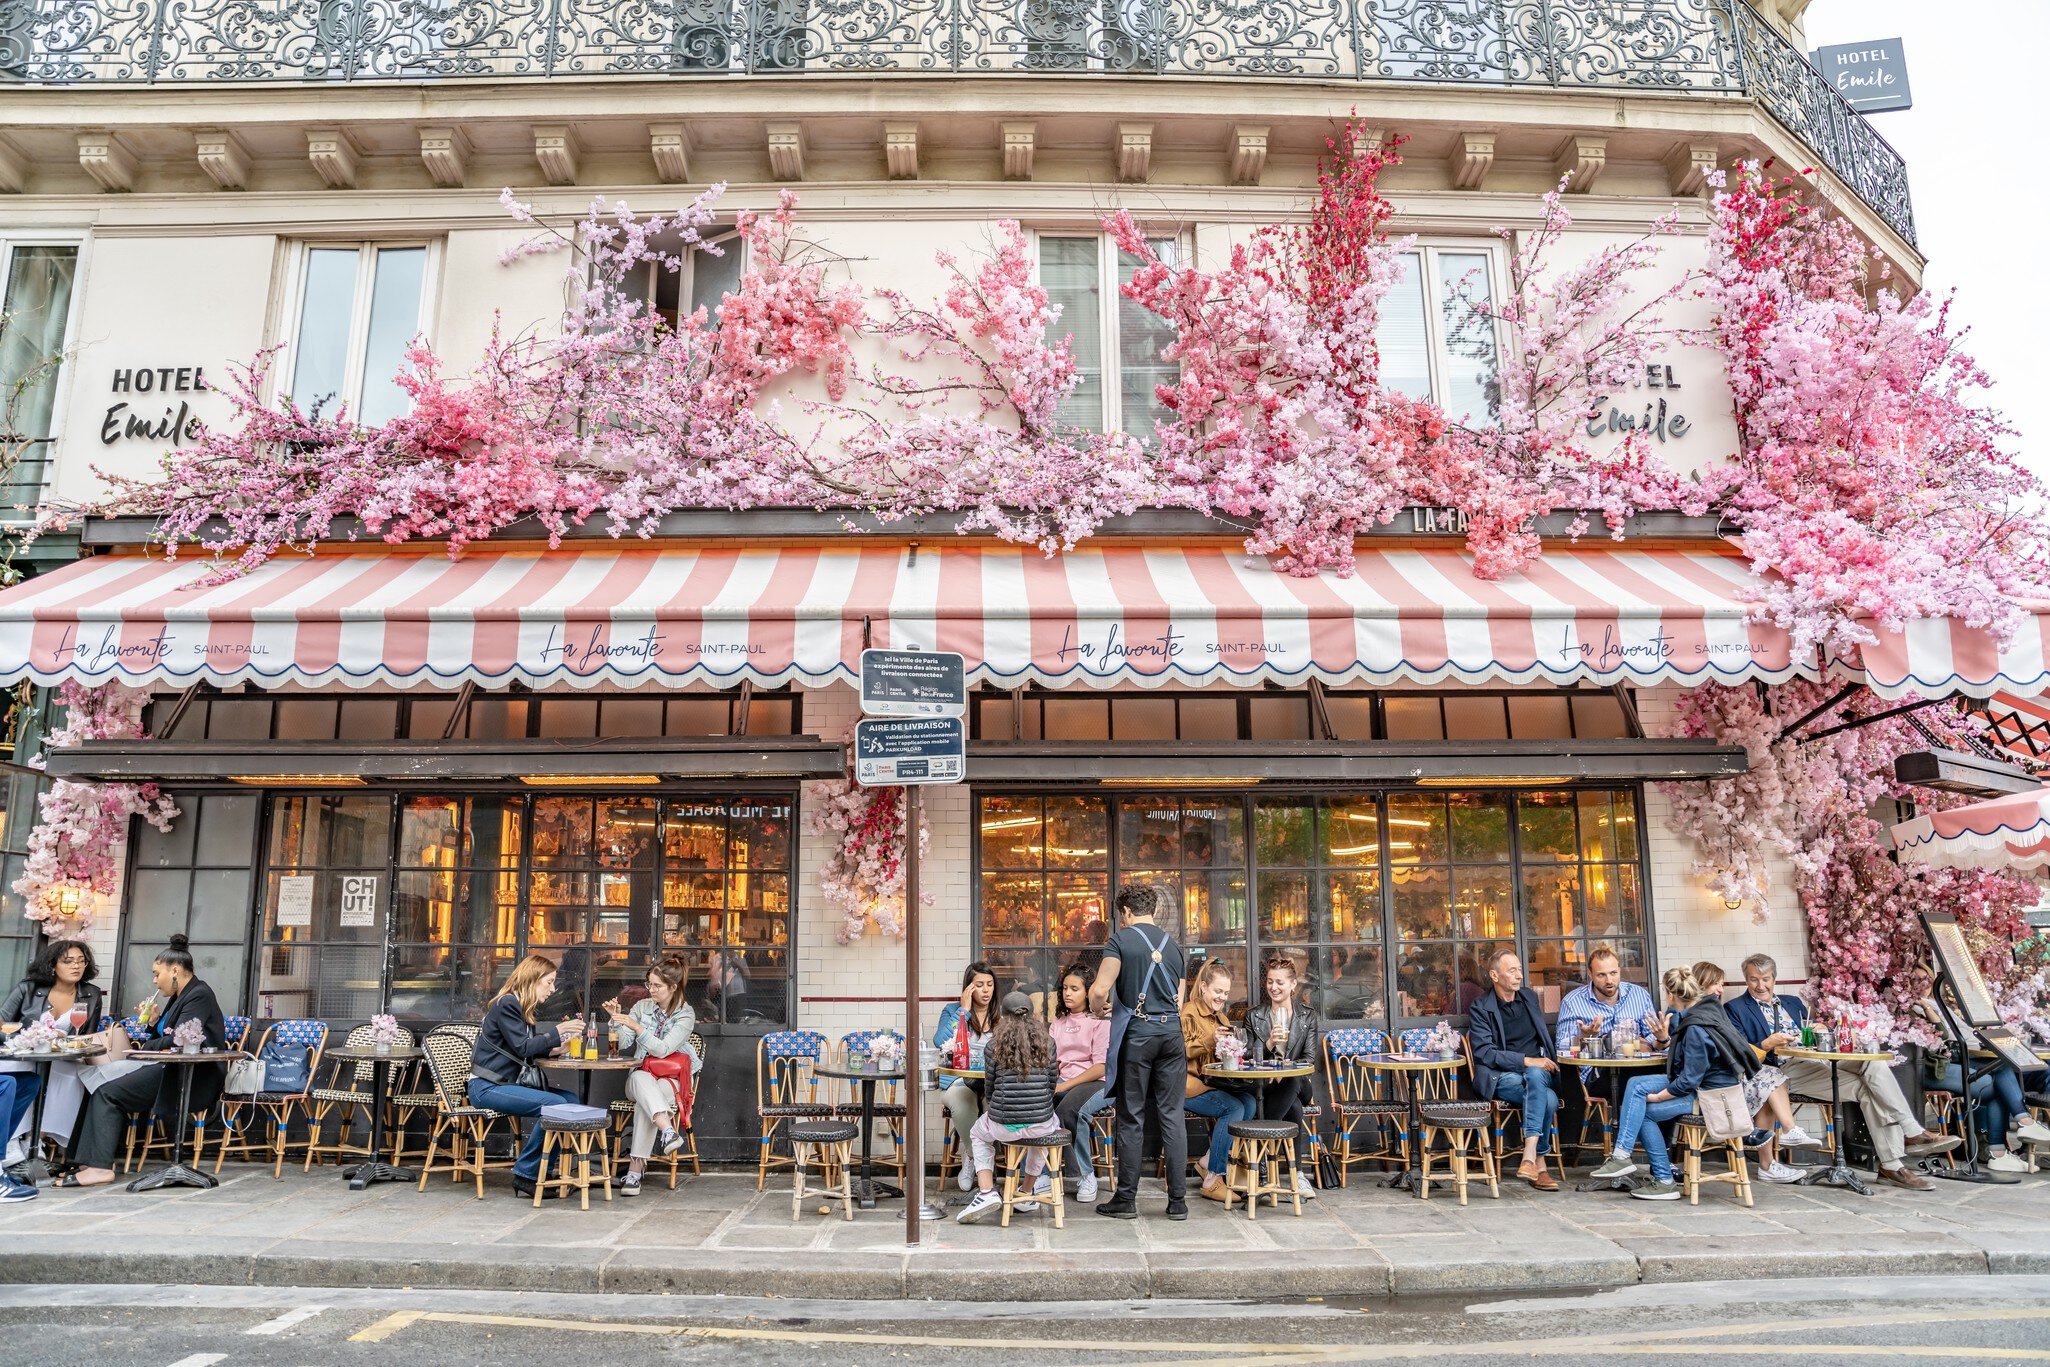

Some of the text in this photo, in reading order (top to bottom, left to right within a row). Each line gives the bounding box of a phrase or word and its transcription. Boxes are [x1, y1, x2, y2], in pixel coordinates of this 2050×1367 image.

[1837, 49, 1889, 65] HOTEL
[1837, 68, 1896, 90] Emile
[112, 367, 207, 392] HOTEL
[1413, 507, 1437, 532] LA
[54, 625, 91, 662] La
[194, 644, 269, 654] SAINT-PAUL
[540, 624, 578, 663] La
[686, 644, 766, 654] SAINT-PAUL
[1057, 625, 1095, 663] La
[1206, 643, 1286, 653] SAINT-PAUL
[1558, 625, 1594, 661] La
[1695, 644, 1768, 654] SAINT-PAUL
[868, 724, 889, 732] AIRE
[904, 721, 951, 730] LIVRAISON
[345, 878, 375, 894] CH
[343, 895, 373, 912] UT!
